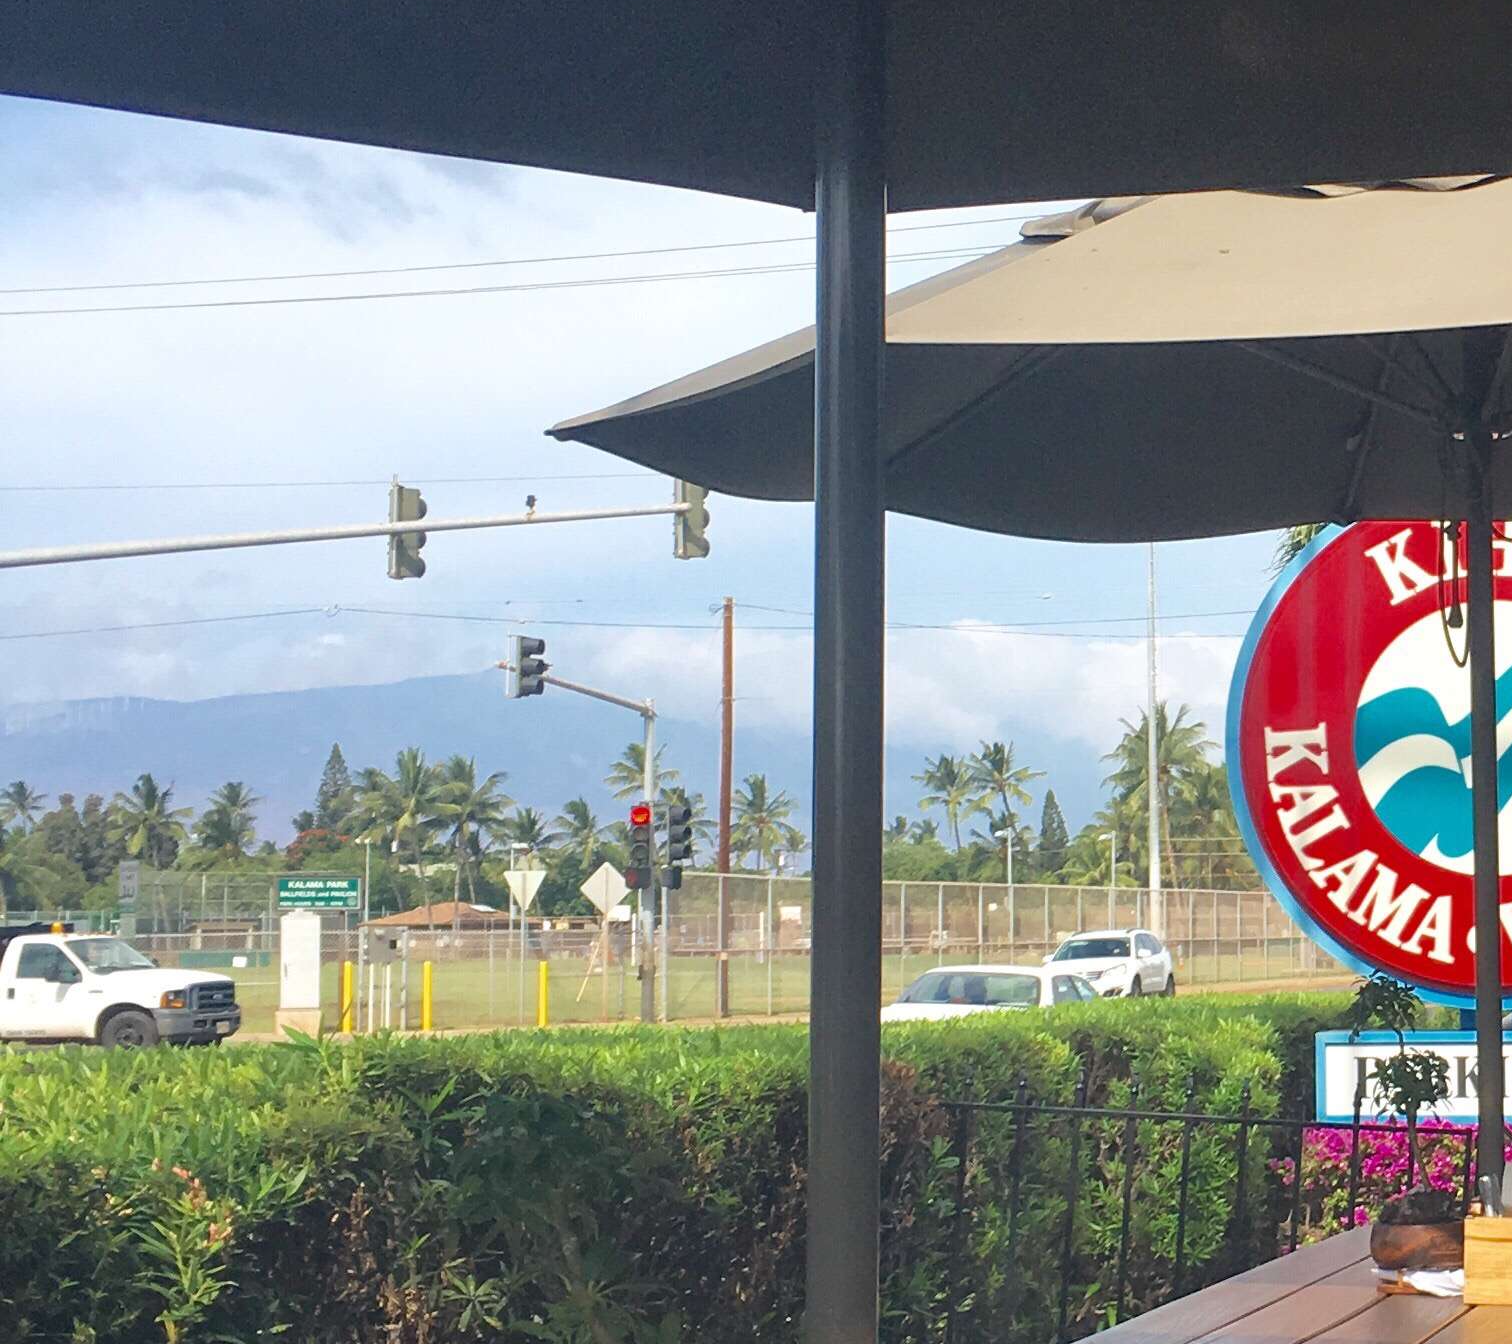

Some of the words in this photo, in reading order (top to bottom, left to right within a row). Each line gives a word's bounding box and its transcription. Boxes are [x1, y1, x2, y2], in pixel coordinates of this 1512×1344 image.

[287, 880, 324, 889] KALAMA
[326, 880, 349, 889] PARK
[1263, 721, 1456, 963] KALAMA
